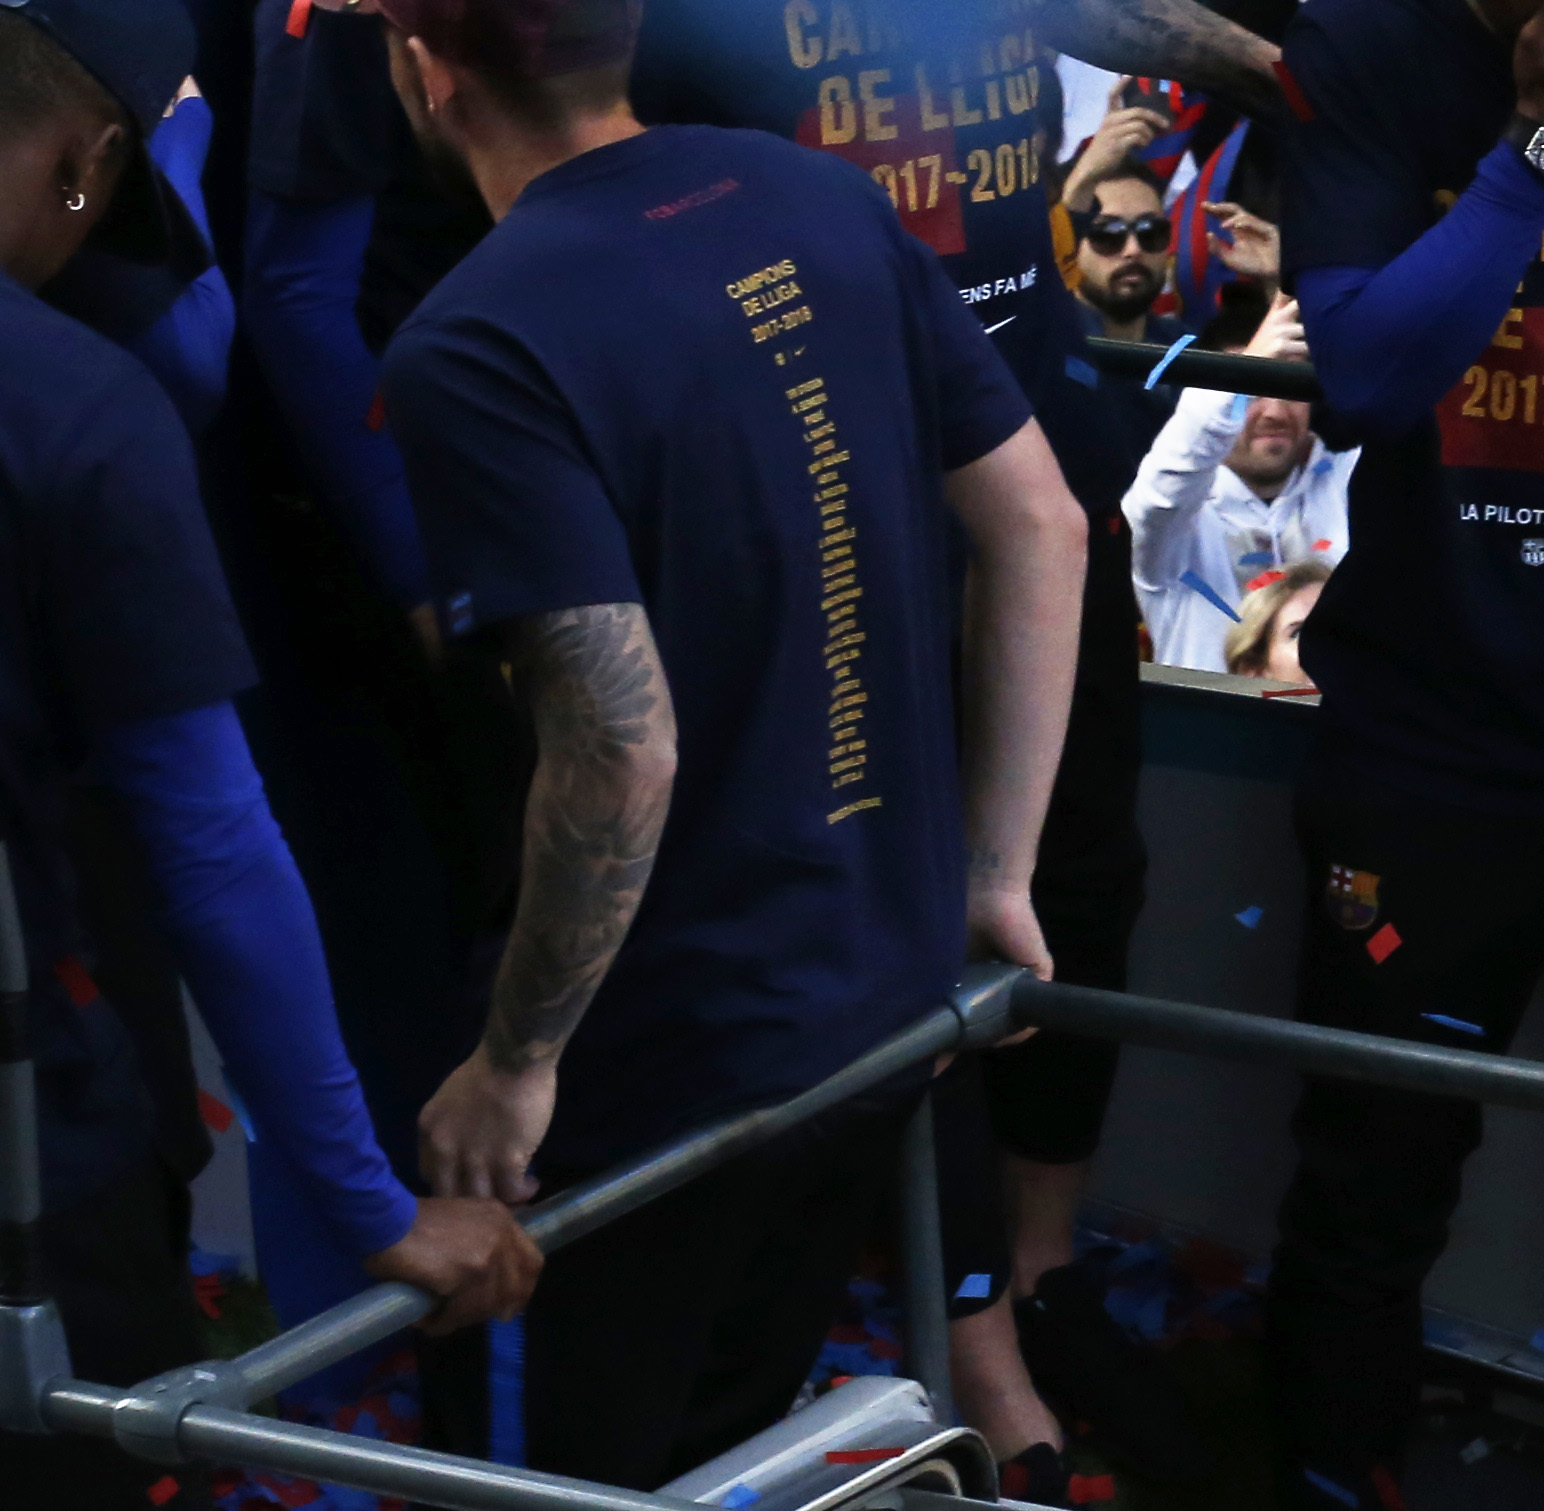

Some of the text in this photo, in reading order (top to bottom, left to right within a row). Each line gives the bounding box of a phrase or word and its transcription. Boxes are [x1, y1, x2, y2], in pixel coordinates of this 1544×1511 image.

[817, 68, 899, 146] DE
[993, 278, 1018, 296] FA
[741, 296, 764, 317] DE
[1459, 503, 1479, 521] LA
